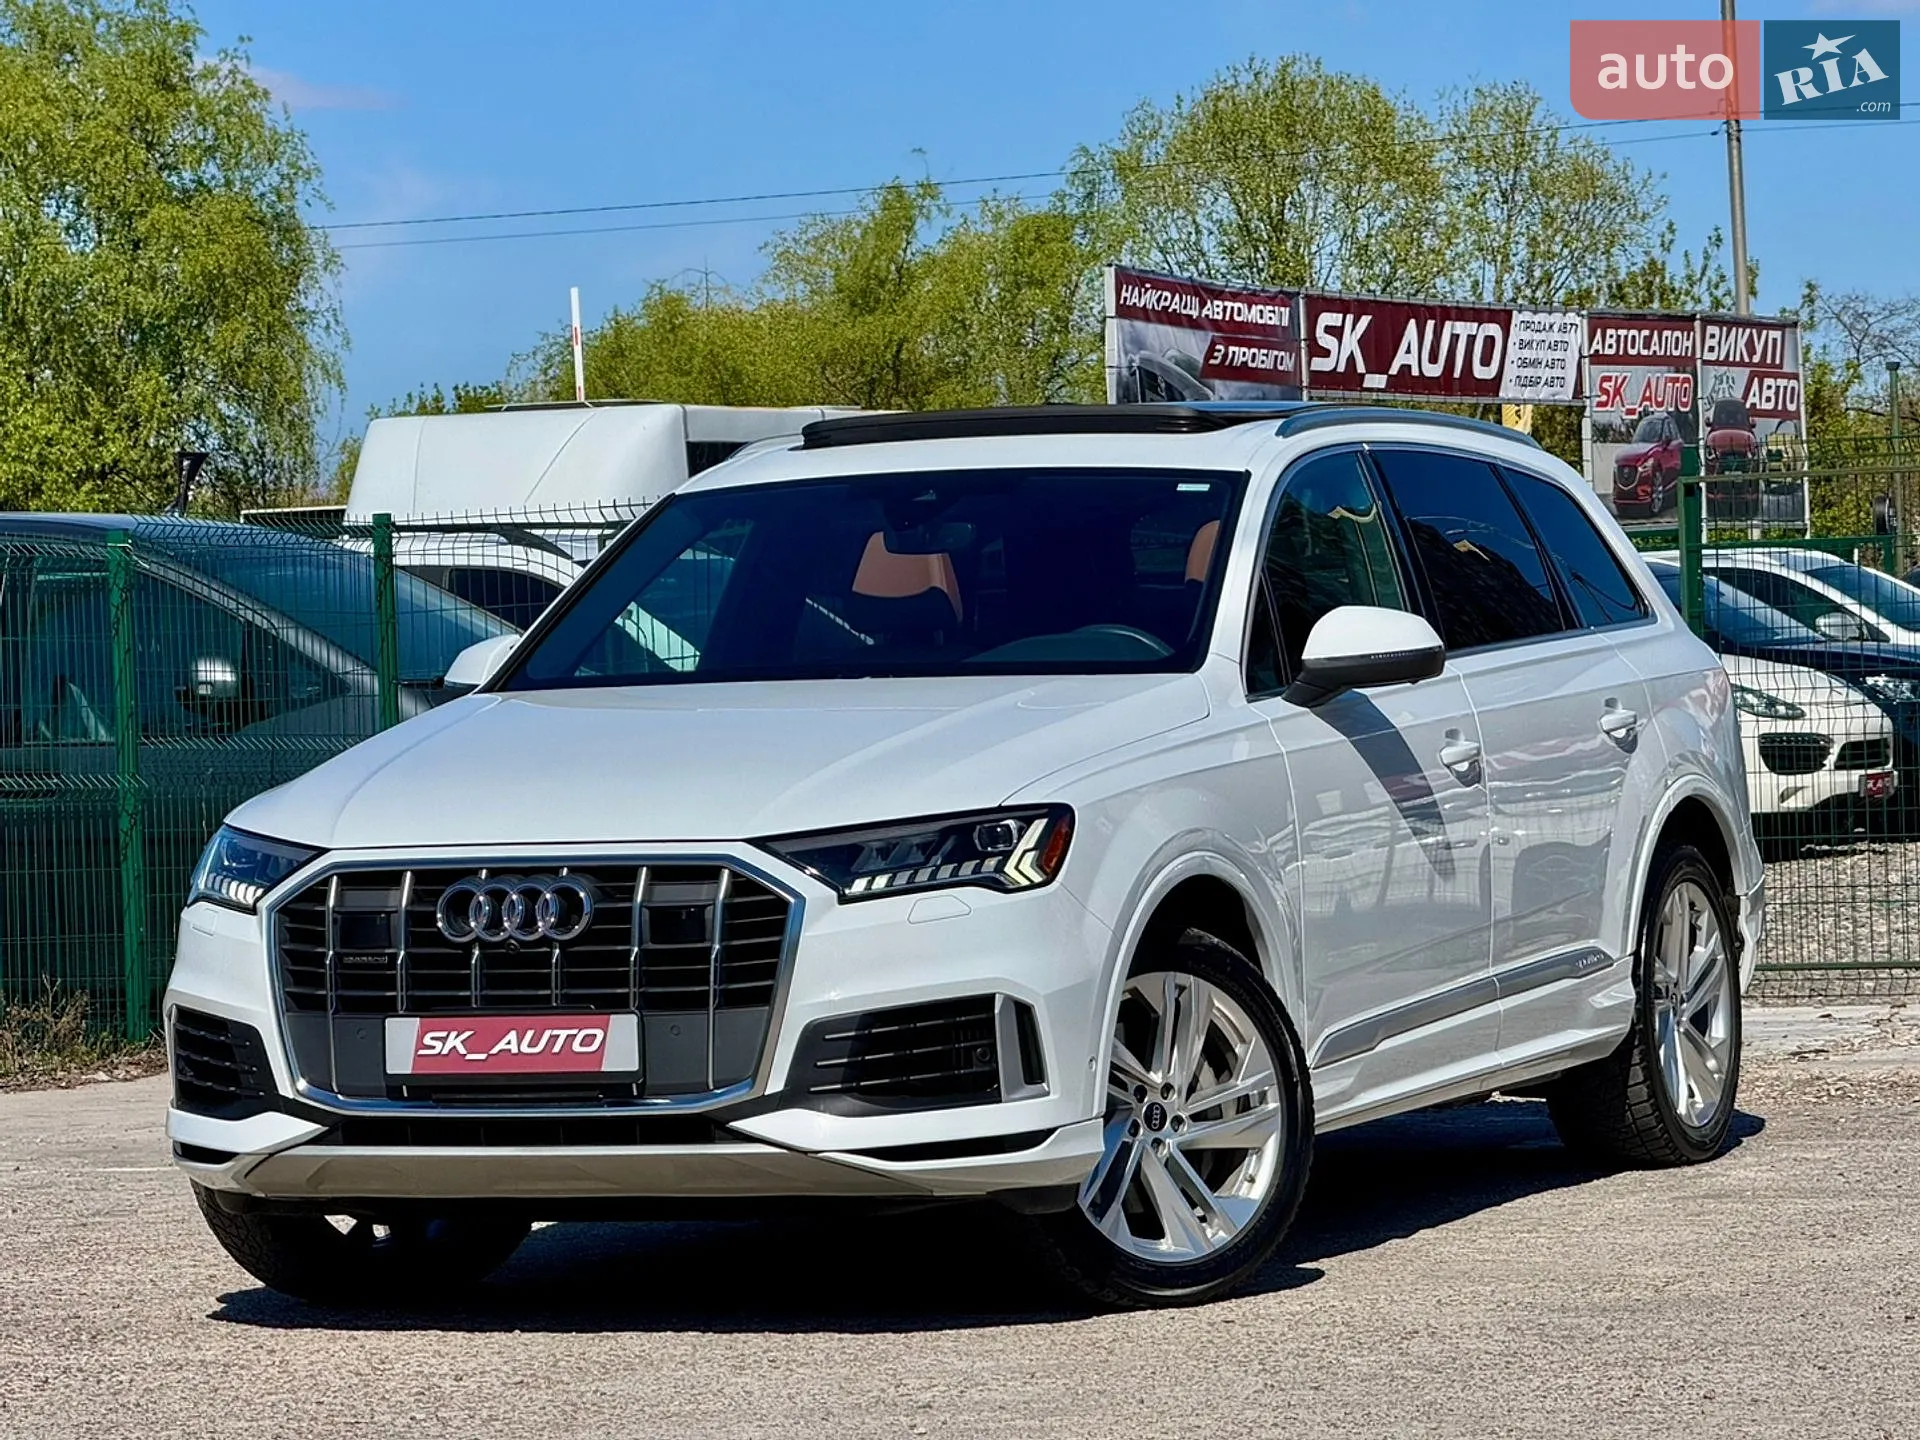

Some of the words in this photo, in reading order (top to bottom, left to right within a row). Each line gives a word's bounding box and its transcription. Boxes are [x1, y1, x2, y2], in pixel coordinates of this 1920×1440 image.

[1119, 284, 1199, 316] НАЙКРАЩІ
[1201, 298, 1290, 327] АВТОМОБІЛІ
[1226, 345, 1295, 372] ПРОБІГОМ
[1310, 312, 1504, 389] SK_AUTO
[1518, 339, 1546, 351] ВИКУП
[1547, 340, 1569, 352] АВТО
[1591, 327, 1694, 357] АВТОСАЛОН
[1703, 325, 1783, 365] ВИКУП
[1516, 357, 1542, 369] ОБМІН
[1544, 358, 1566, 370] АВТО
[1542, 376, 1566, 388] АВТО
[1595, 371, 1693, 418] SK_AUTO
[1745, 377, 1799, 412] АВТО
[417, 1027, 606, 1060] SK_AUTO
